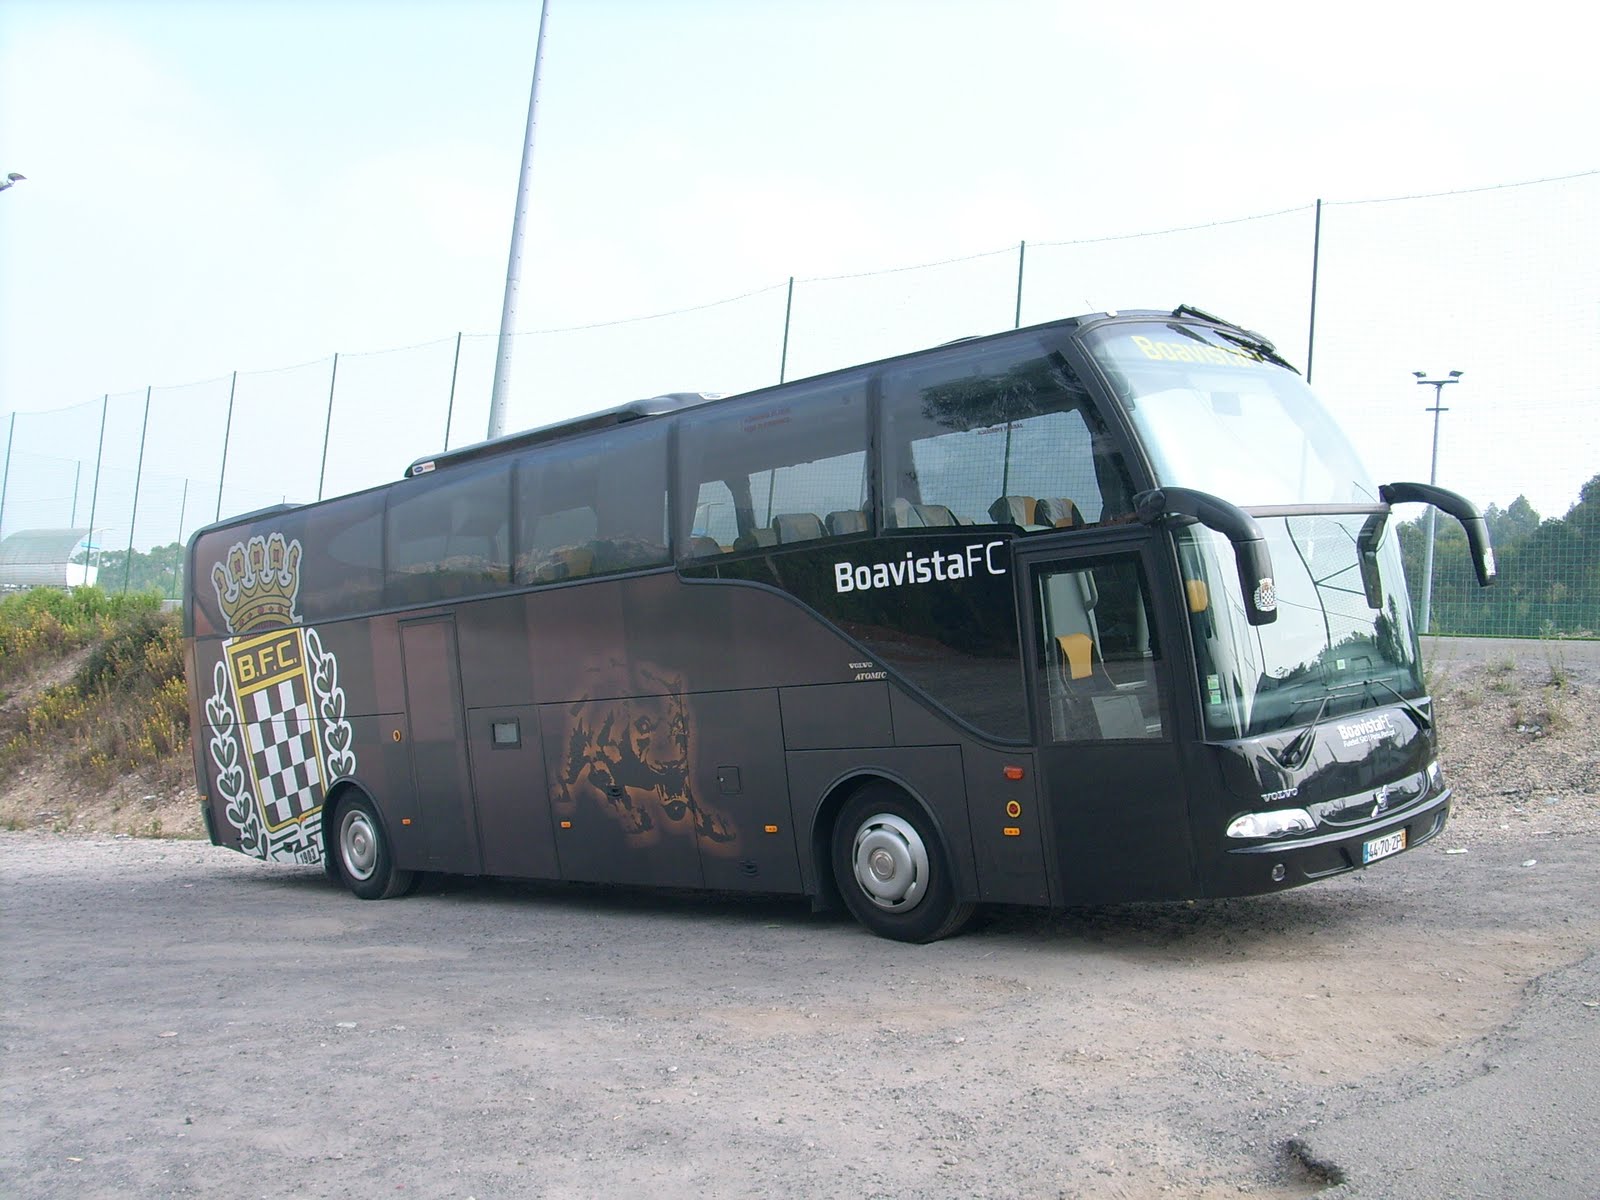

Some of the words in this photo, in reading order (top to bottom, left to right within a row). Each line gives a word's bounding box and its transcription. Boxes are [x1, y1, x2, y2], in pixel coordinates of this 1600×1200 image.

[834, 541, 1006, 593] BoavistaFC
[237, 640, 297, 683] B.F.C.
[848, 661, 873, 669] VOLVO
[854, 671, 887, 681] ATOMIC
[1337, 713, 1394, 740] BoavistaFC
[1260, 787, 1299, 803] VOLVO
